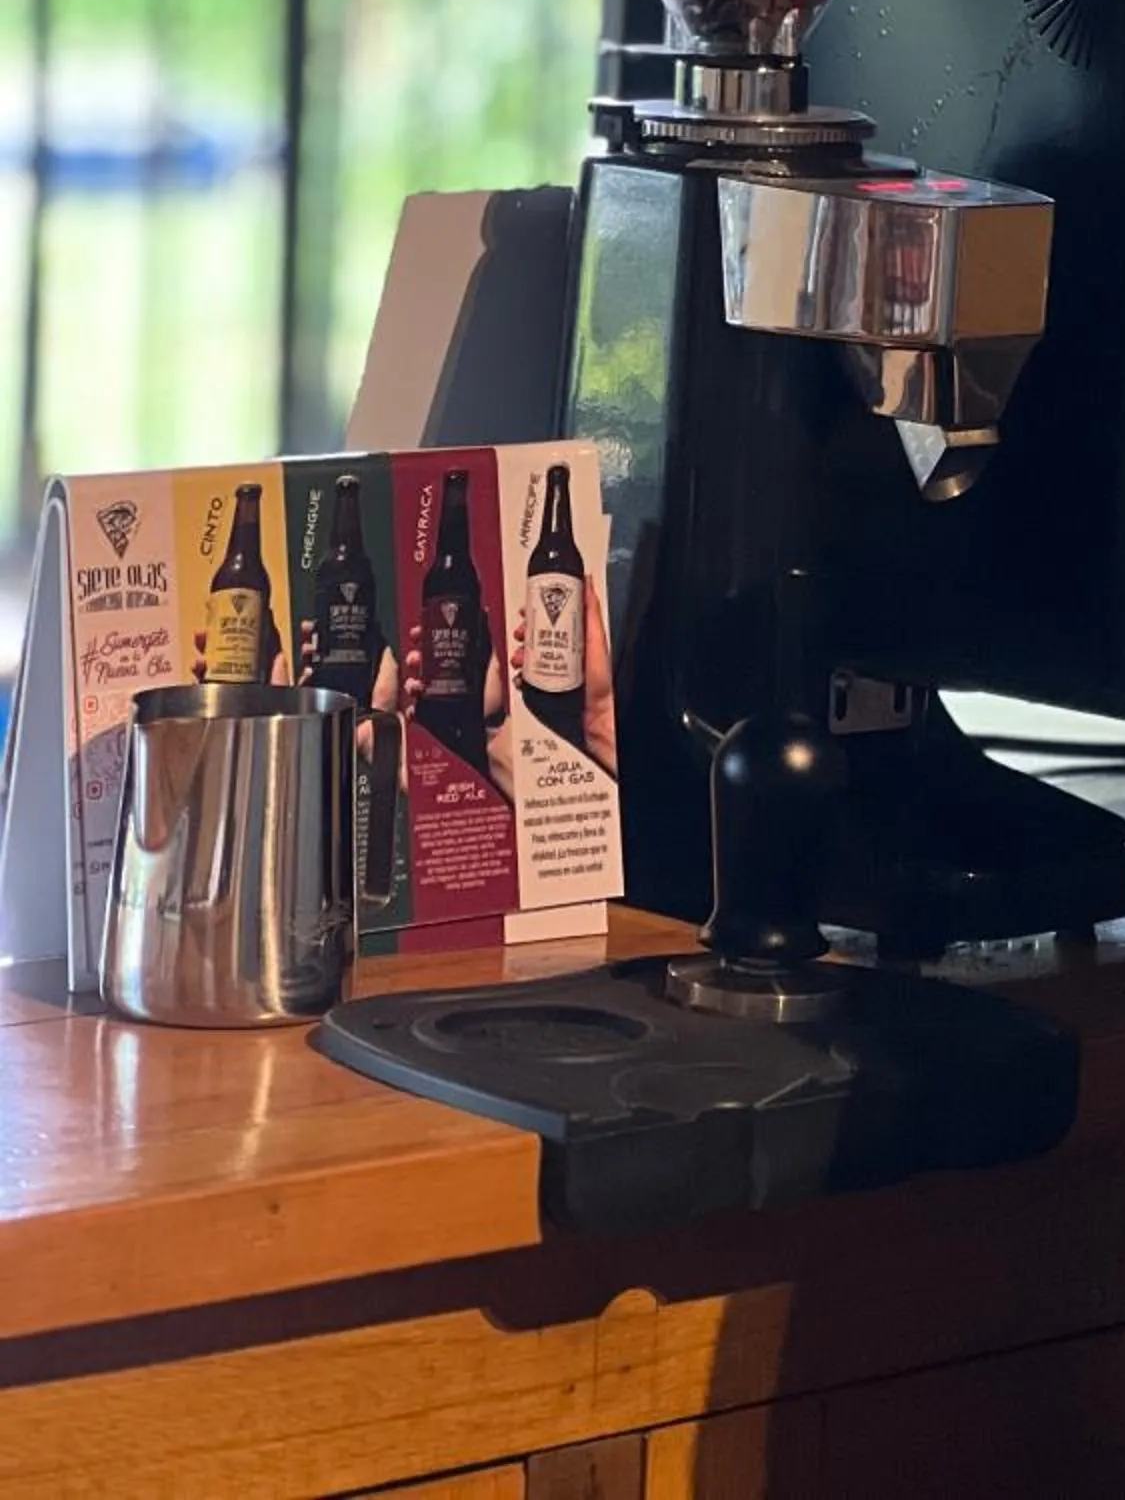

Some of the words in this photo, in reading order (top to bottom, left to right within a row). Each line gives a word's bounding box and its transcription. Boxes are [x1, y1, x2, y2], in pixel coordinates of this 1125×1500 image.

[201, 497, 223, 556] CINTO
[301, 489, 321, 569] CHENGUE
[537, 774, 564, 788] CON
[569, 771, 595, 785] GAS
[548, 760, 583, 773] AGUA
